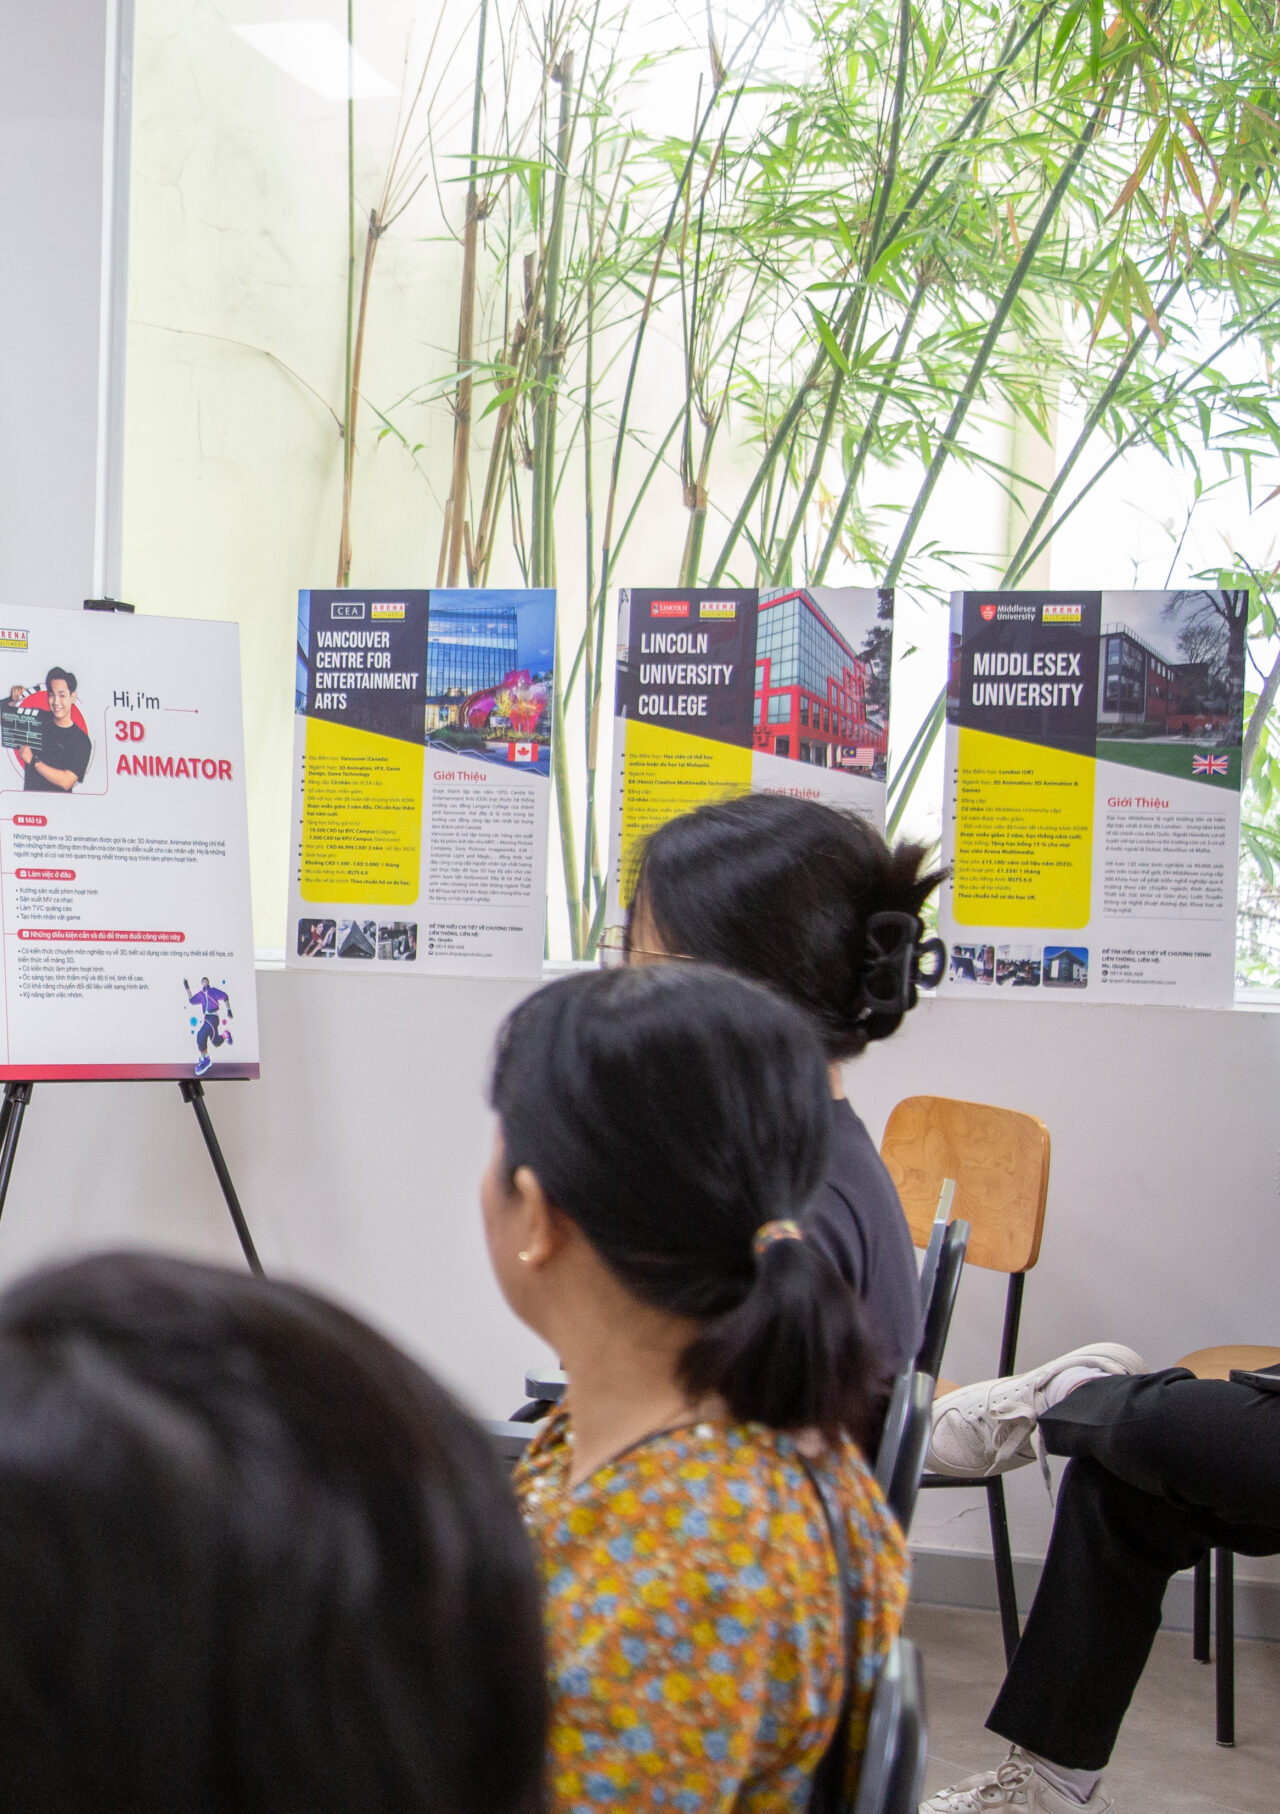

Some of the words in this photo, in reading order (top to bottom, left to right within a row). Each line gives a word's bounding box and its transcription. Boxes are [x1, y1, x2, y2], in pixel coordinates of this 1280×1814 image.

[337, 607, 358, 616] CEA
[996, 612, 1036, 622] University
[997, 604, 1036, 613] Middlesex
[317, 631, 390, 649] VANCOUVER
[641, 633, 708, 654] LINCOLN
[316, 651, 364, 669] CENTRE
[367, 651, 391, 669] FOR
[973, 652, 1081, 677] MIDDLESEX
[315, 672, 419, 690] ENTERTAINMENT
[639, 664, 733, 685] UNIVERSITY
[113, 691, 134, 711] Hi,
[314, 693, 347, 710] ARTS
[972, 683, 1084, 707] UNIVERSITY
[638, 695, 708, 716] COLLEGE
[114, 720, 145, 742] 3D
[116, 754, 233, 780] ANIMATOR
[433, 771, 455, 781] Giới
[458, 771, 487, 783] Thiệu
[788, 788, 820, 800] Thiệu
[1107, 797, 1133, 809] Giới
[1134, 797, 1169, 811] Thiệu
[42, 871, 54, 879] việc
[31, 931, 51, 939] Những
[66, 931, 78, 939] kiện
[142, 933, 157, 941] công
[158, 934, 169, 942] việc
